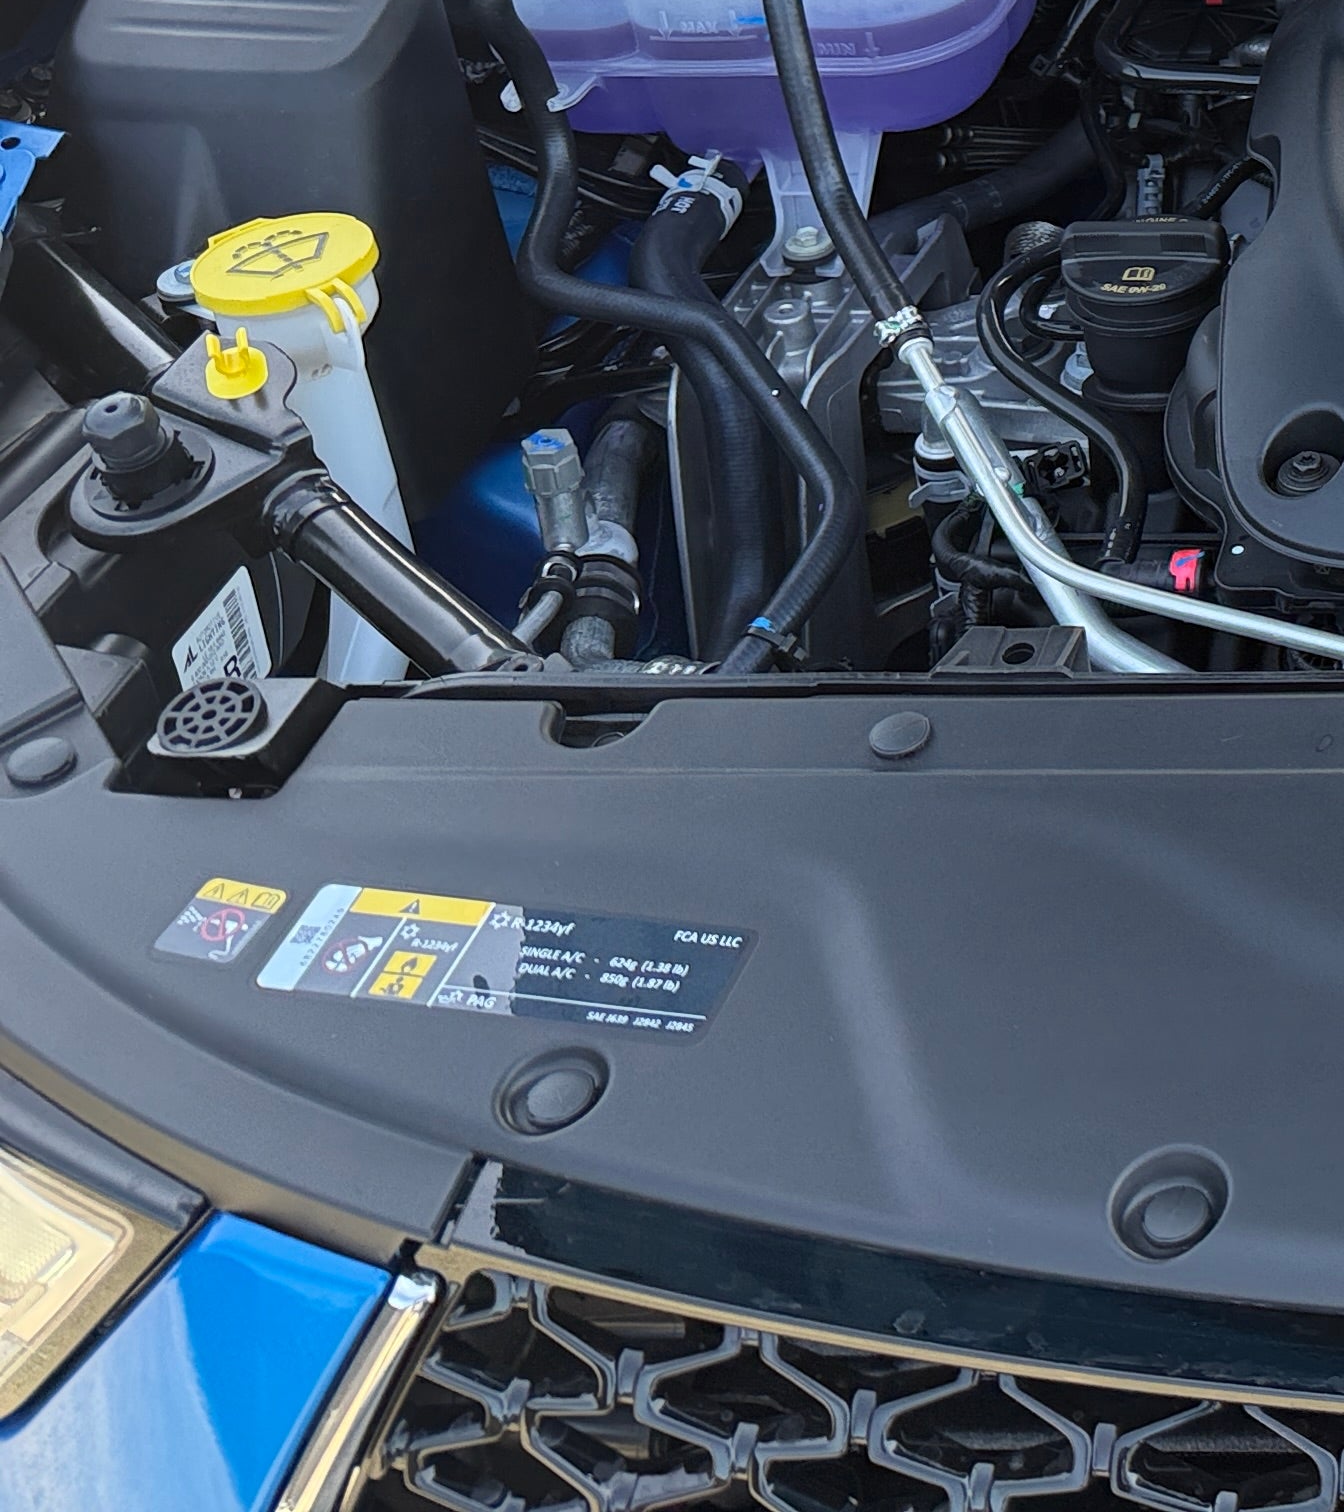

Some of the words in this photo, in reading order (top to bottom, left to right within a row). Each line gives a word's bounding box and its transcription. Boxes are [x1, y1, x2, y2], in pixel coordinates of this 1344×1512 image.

[679, 20, 718, 33] MAX
[670, 195, 696, 214] HOT
[1101, 283, 1127, 294] SAE
[198, 616, 226, 653] LIGHTING
[511, 917, 576, 937] R-1234yf
[673, 929, 698, 944] FCA
[700, 932, 718, 946] US
[718, 934, 743, 948] LLC
[519, 946, 561, 962] SINGLE
[561, 950, 586, 964] A/C
[609, 956, 637, 972] 624g
[640, 959, 671, 974] (1.38
[671, 962, 689, 977] lb)
[517, 962, 551, 977] DUAL
[551, 966, 577, 980] A/C
[600, 972, 630, 988] 850g
[631, 975, 663, 990] (1.87
[663, 978, 681, 993] lb)
[466, 994, 497, 1009] PAG
[586, 1011, 604, 1023] SAE
